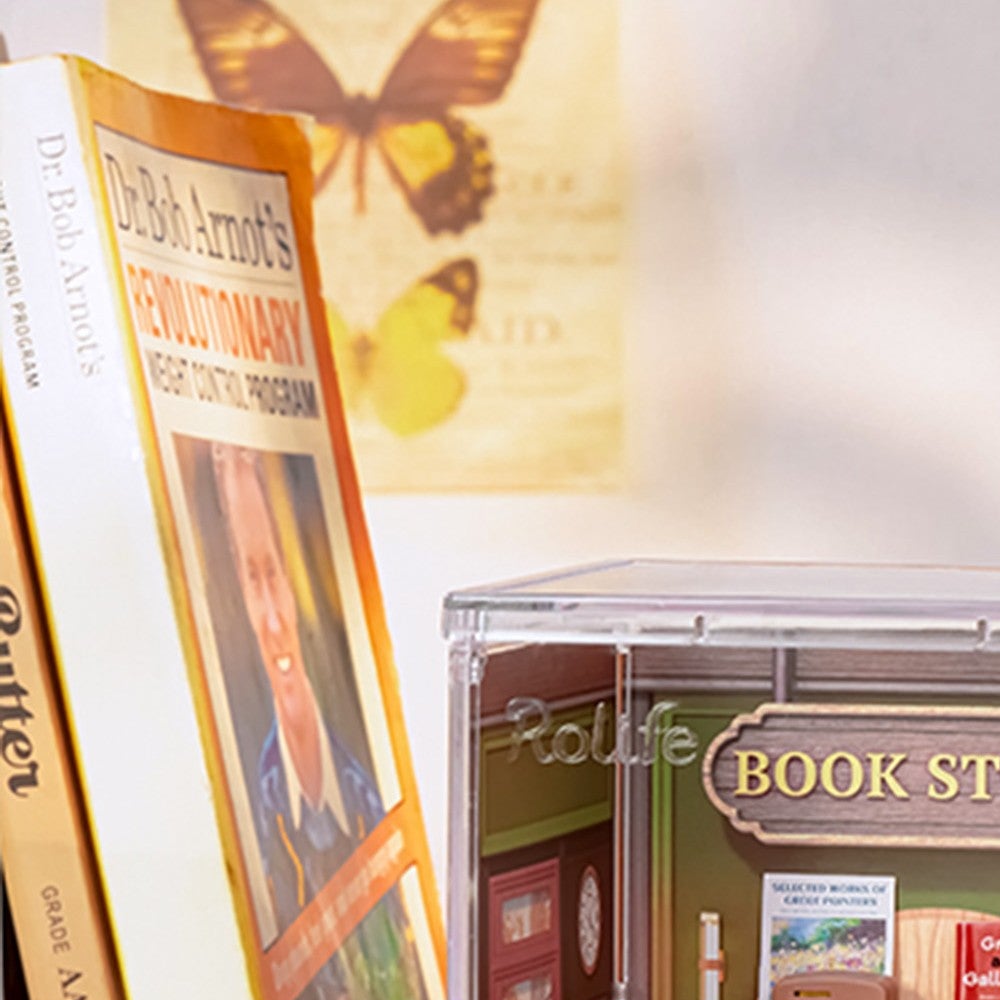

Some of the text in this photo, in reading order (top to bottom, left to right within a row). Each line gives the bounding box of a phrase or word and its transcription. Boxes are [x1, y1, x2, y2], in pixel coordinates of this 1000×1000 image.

[104, 152, 147, 237] Dr.
[137, 166, 190, 252] Bob
[190, 182, 293, 272] Arnot's
[37, 133, 102, 379] Dr. Bob Arnot's
[11, 301, 41, 391] PROGRAM
[127, 263, 307, 367] REVOLUTIONARY
[245, 373, 321, 420] PROGRAM
[507, 697, 698, 767] Rolife
[733, 749, 911, 800] BOOK
[41, 885, 71, 954] GRADE
